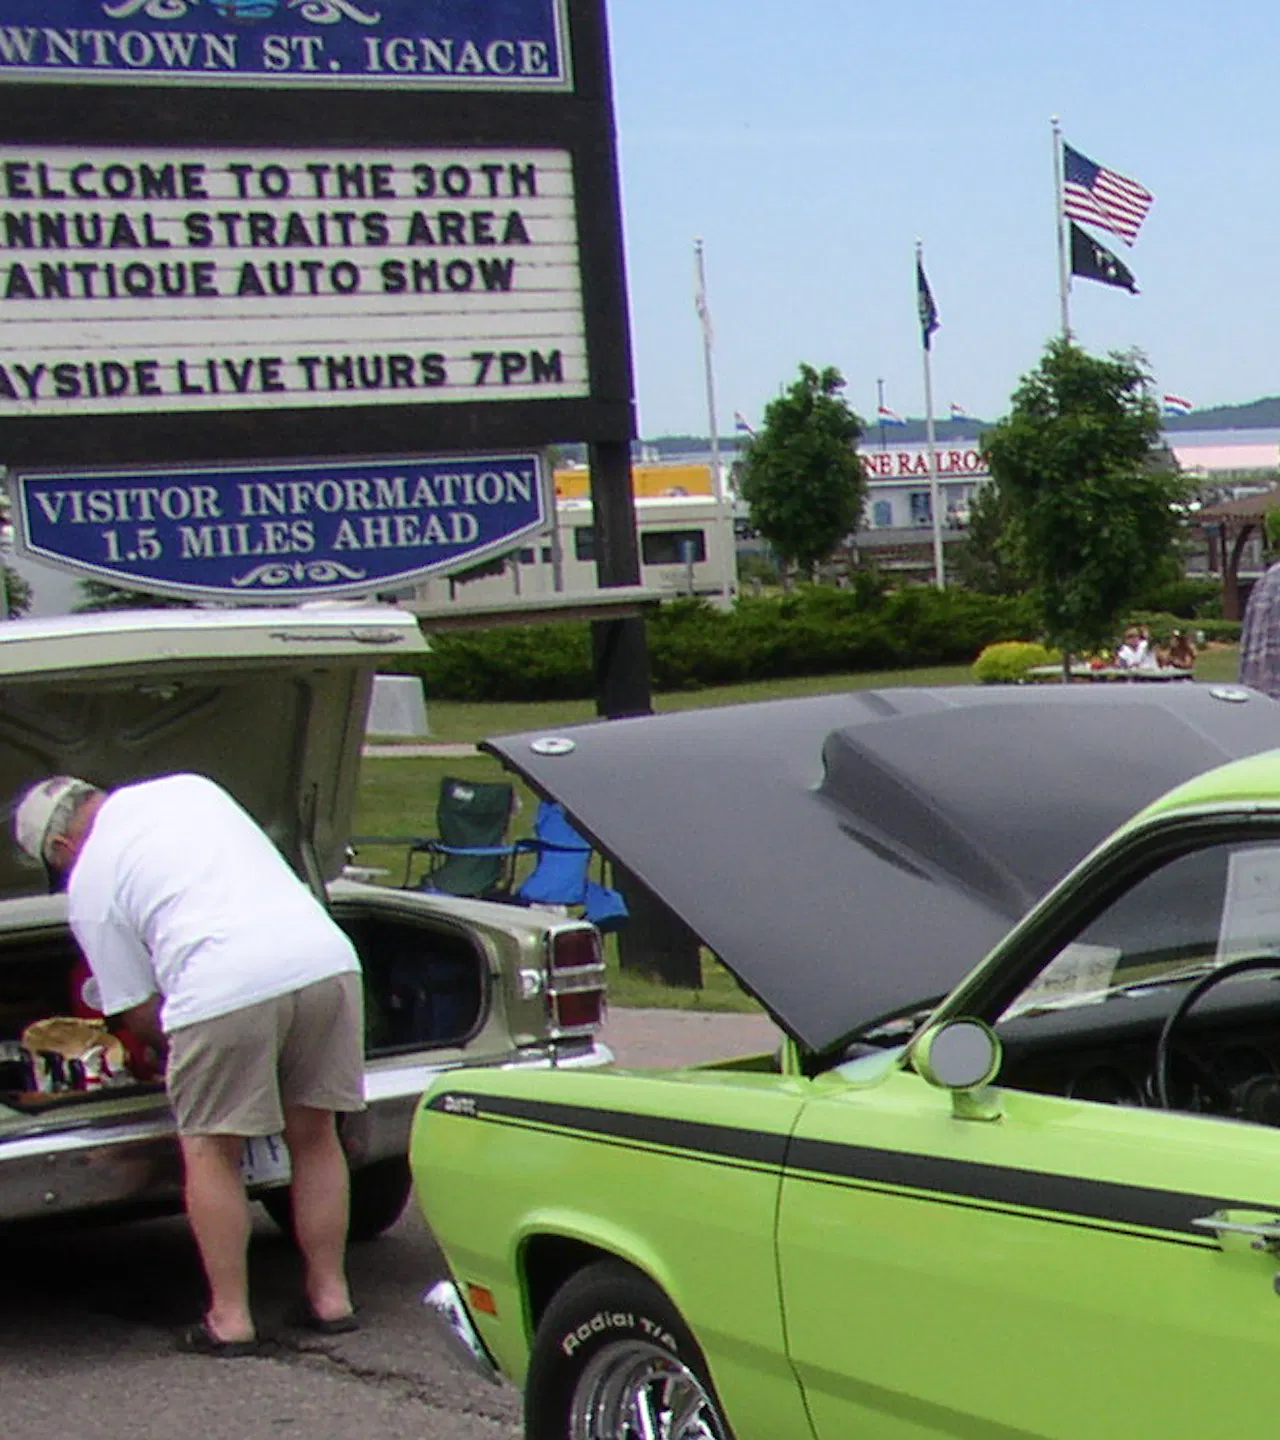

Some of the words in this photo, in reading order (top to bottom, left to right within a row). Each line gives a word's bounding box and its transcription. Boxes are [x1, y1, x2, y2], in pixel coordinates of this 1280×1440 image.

[262, 35, 342, 72] ST.
[364, 37, 549, 75] IGNACE
[3, 162, 208, 199] ELCOME
[229, 163, 291, 199] TO
[306, 163, 396, 198] THE
[411, 163, 538, 198] 30TH
[184, 211, 391, 248] STRAITS
[407, 209, 532, 246] AREA
[4, 261, 220, 299] ANTIQUE
[237, 259, 361, 297] AUTO
[380, 257, 515, 293] SHOW
[176, 356, 286, 394] LIVE
[297, 353, 449, 391] THURS
[470, 349, 564, 386] 7PM
[33, 485, 223, 524] VISITOR
[238, 471, 533, 516] INFORMATION
[102, 526, 163, 562] 1.5
[178, 519, 316, 559] MILES
[333, 512, 480, 550] AHEAD
[562, 1311, 634, 1356] Radial
